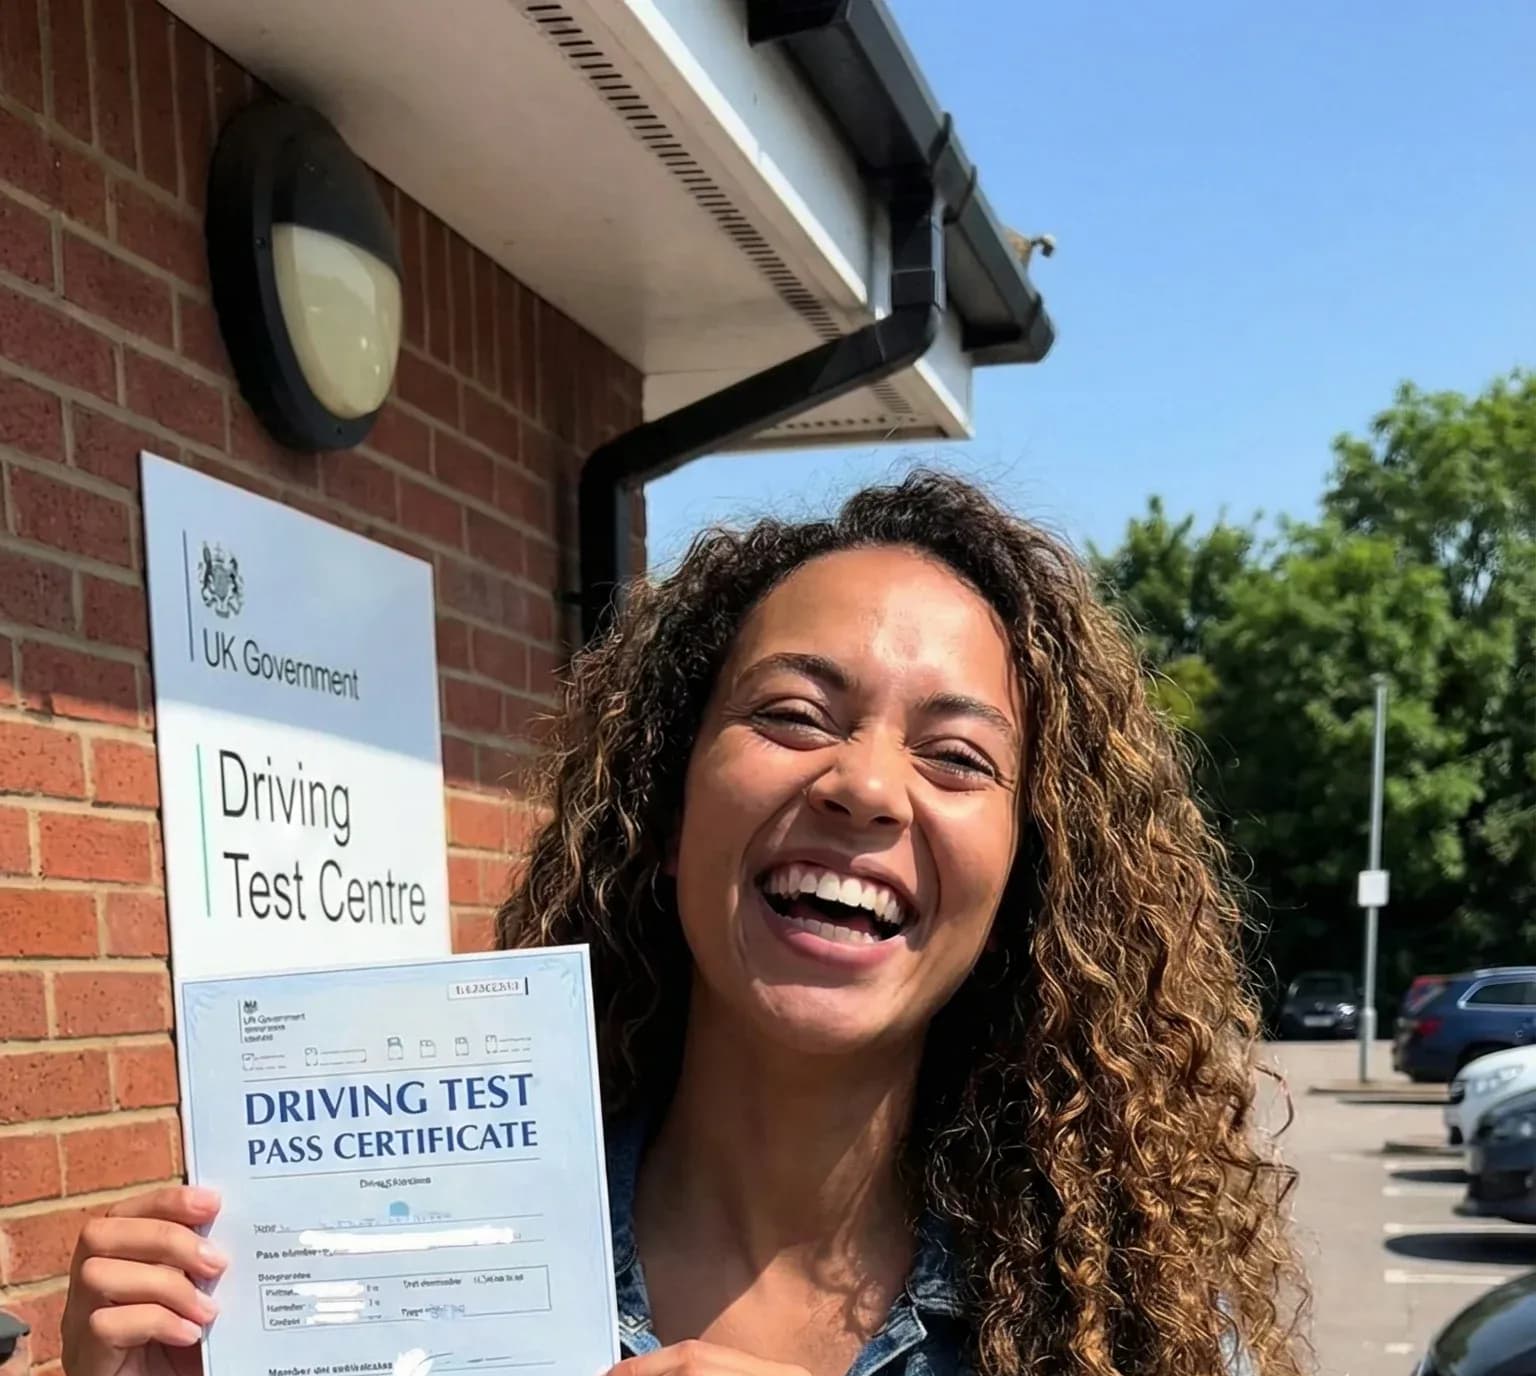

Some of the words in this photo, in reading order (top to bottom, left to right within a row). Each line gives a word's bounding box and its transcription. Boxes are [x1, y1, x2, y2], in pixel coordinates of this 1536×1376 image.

[203, 628, 238, 672] UK
[243, 639, 360, 701] Government
[219, 749, 351, 847] Driving
[223, 851, 307, 921] Test
[319, 859, 427, 925] Centre
[245, 1081, 428, 1125] DRIVING
[439, 1073, 533, 1112] TEST
[248, 1135, 323, 1165] PASS
[334, 1120, 538, 1160] CERTIFICATE
